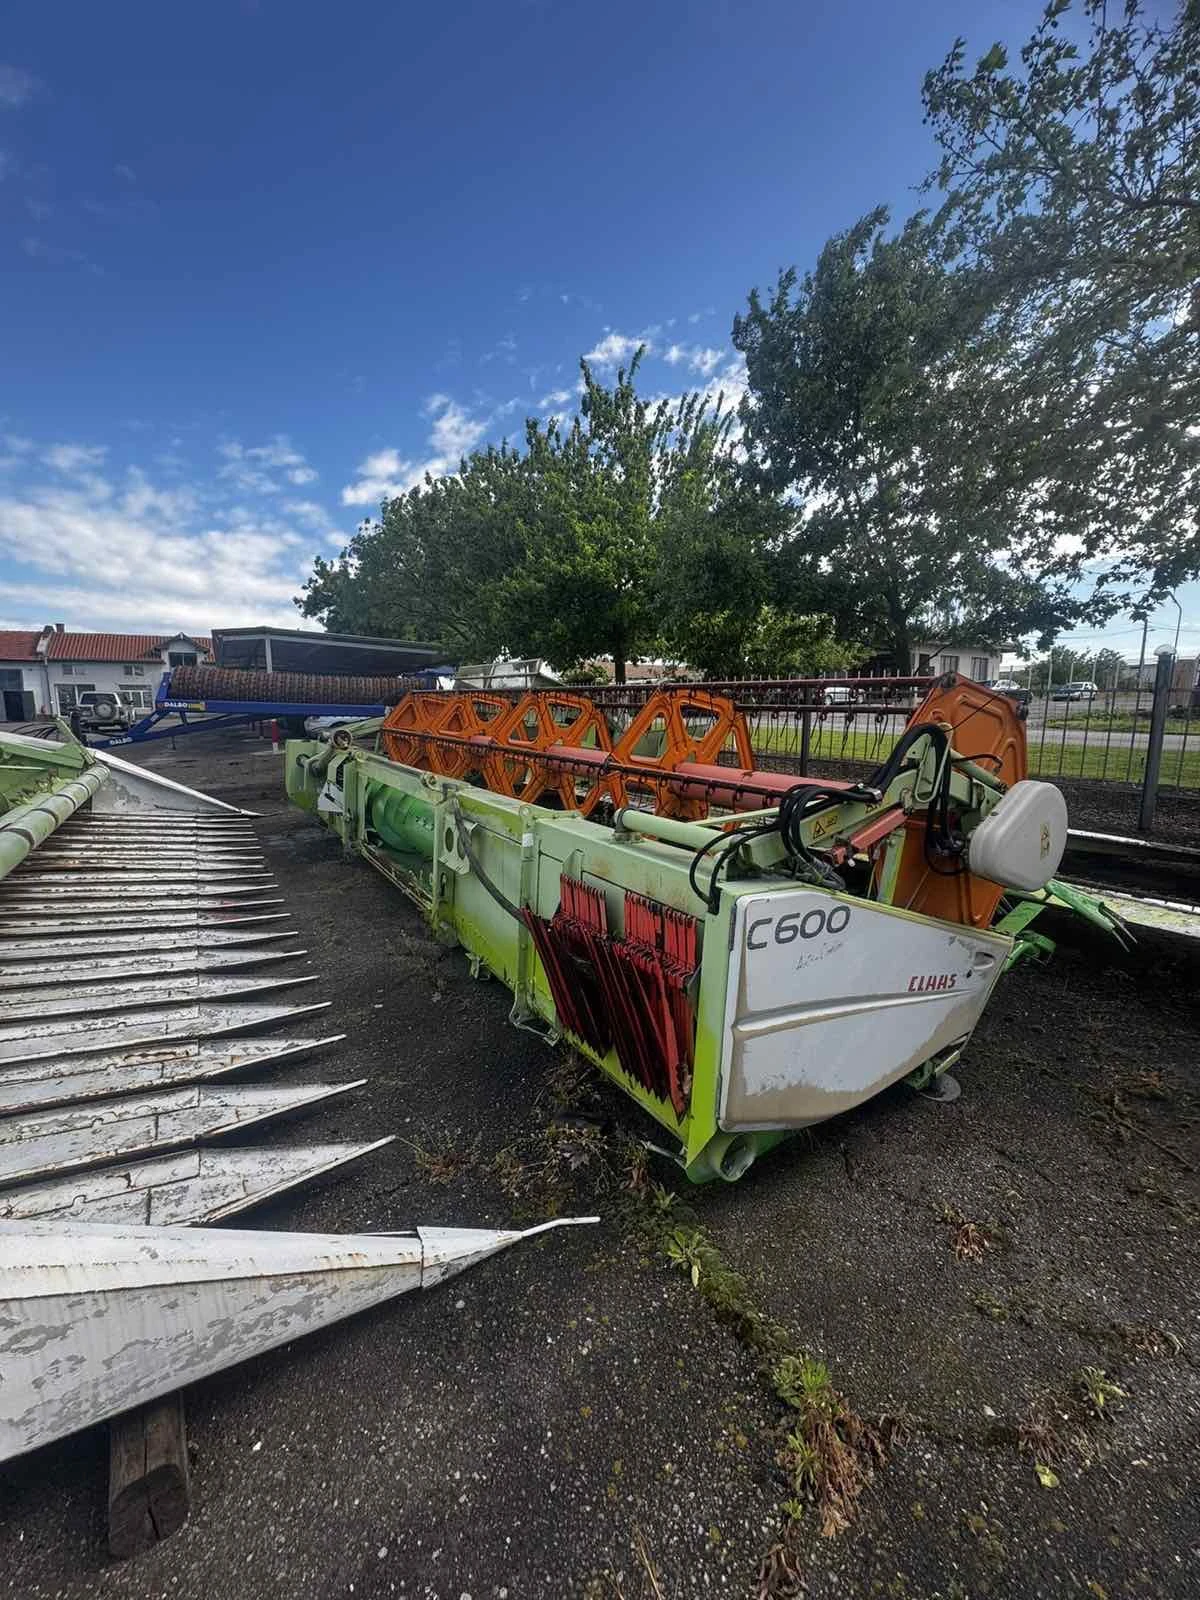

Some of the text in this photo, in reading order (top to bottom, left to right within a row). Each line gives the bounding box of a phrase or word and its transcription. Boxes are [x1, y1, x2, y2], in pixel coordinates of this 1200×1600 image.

[164, 701, 188, 709] DALBO
[747, 905, 851, 950] C600
[908, 973, 957, 991] CLAAS
